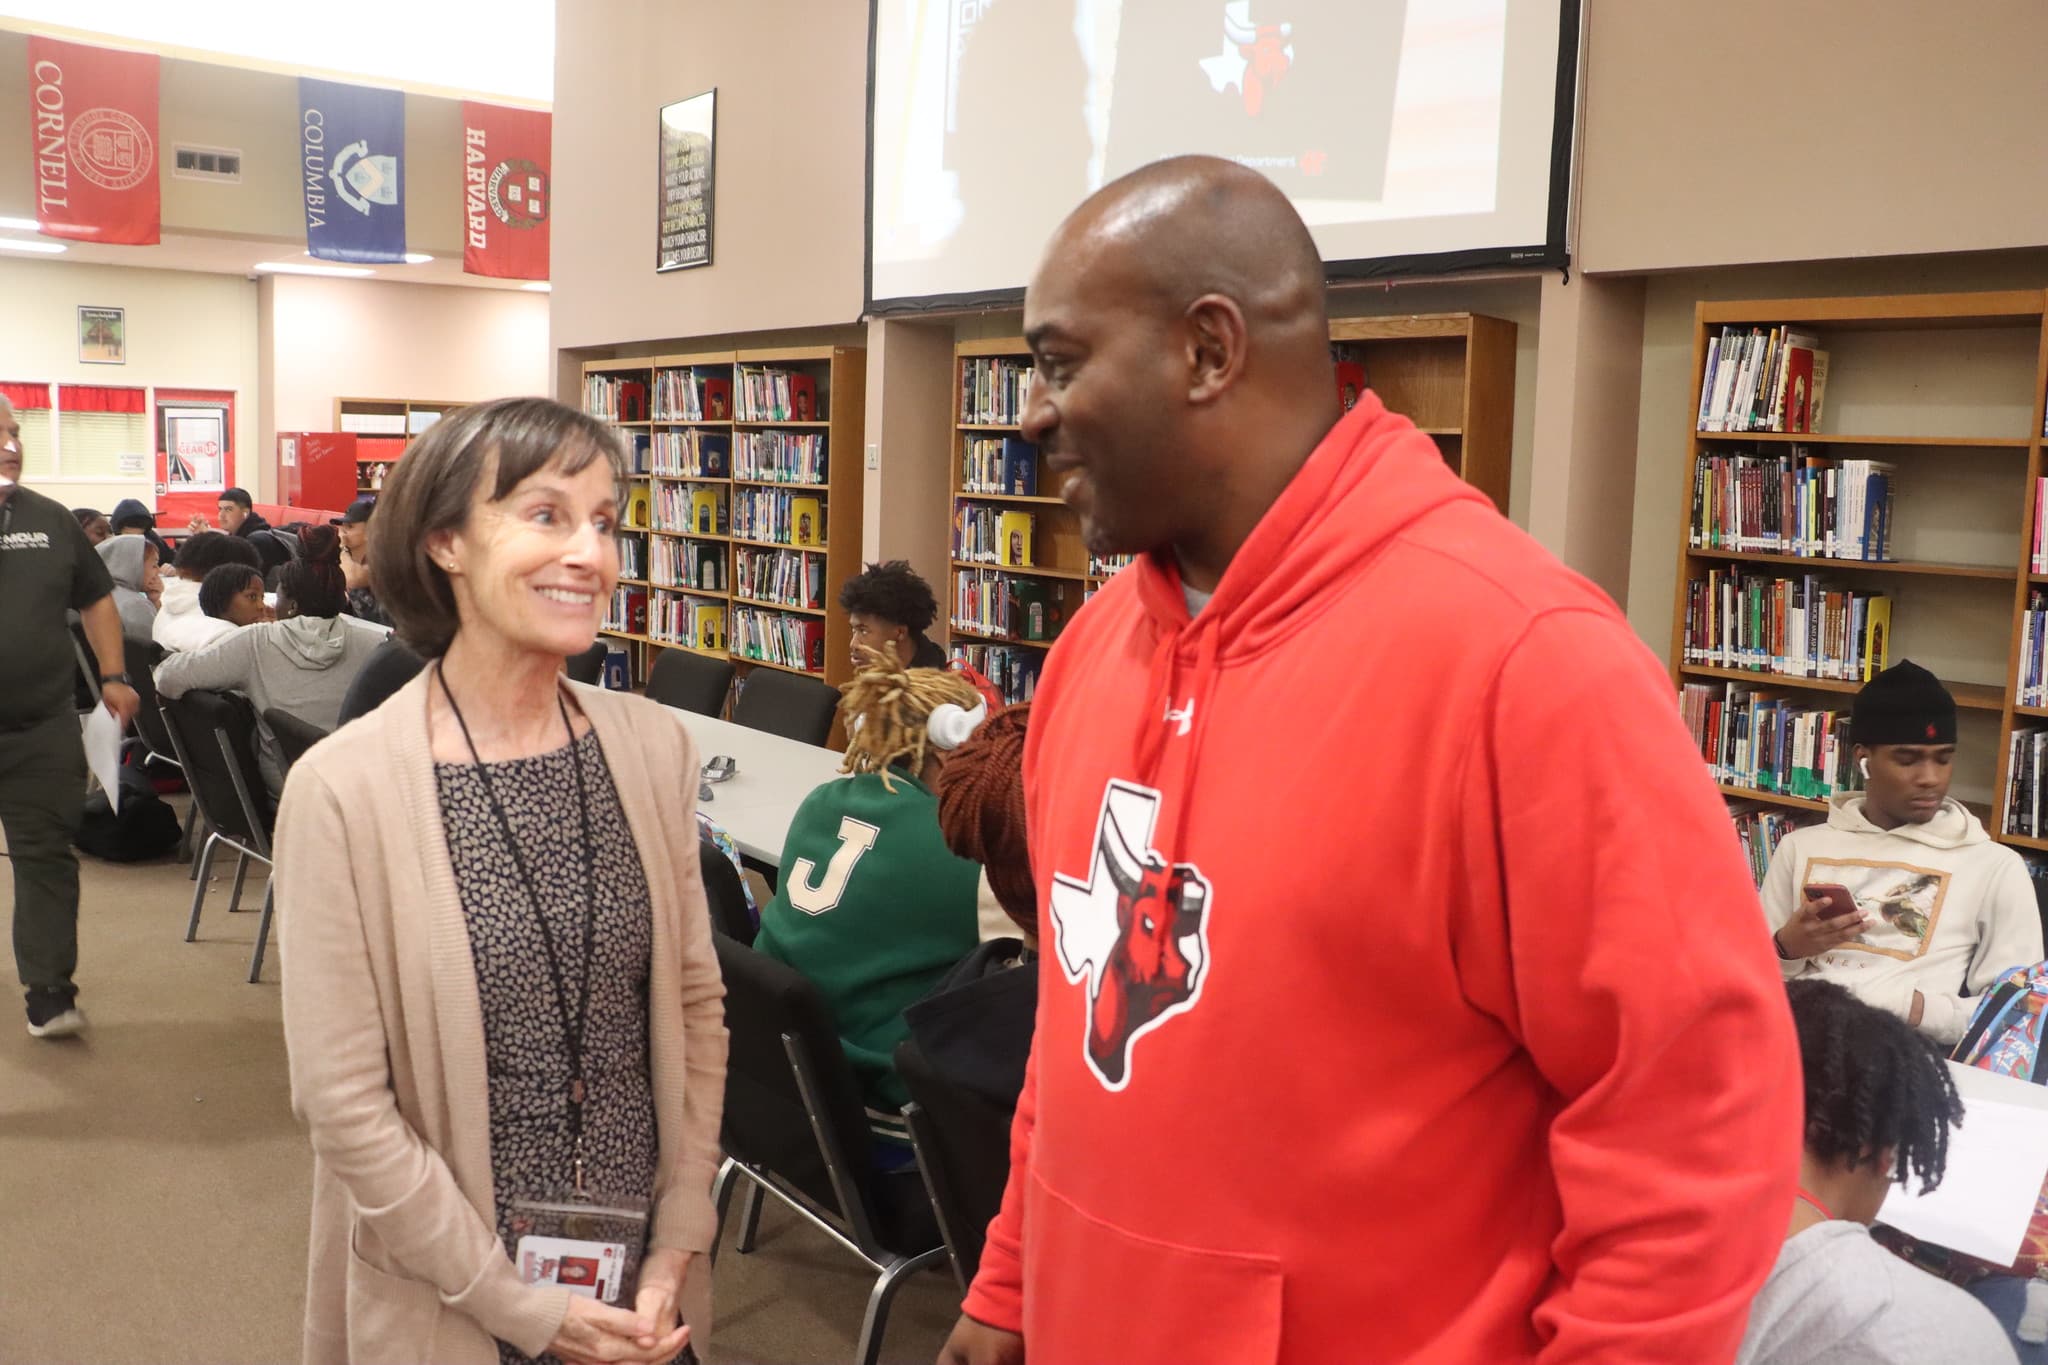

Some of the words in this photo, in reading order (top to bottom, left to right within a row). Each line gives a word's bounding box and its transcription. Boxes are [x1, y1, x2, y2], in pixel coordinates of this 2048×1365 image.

[34, 60, 68, 214] CORNELL
[304, 108, 327, 228] COLUMBIA
[466, 127, 487, 249] HARVARD
[488, 165, 506, 216] HARVARD
[178, 444, 205, 456] GEAR
[206, 441, 218, 456] UP
[0, 532, 49, 545] MOUR
[786, 815, 880, 916] J
